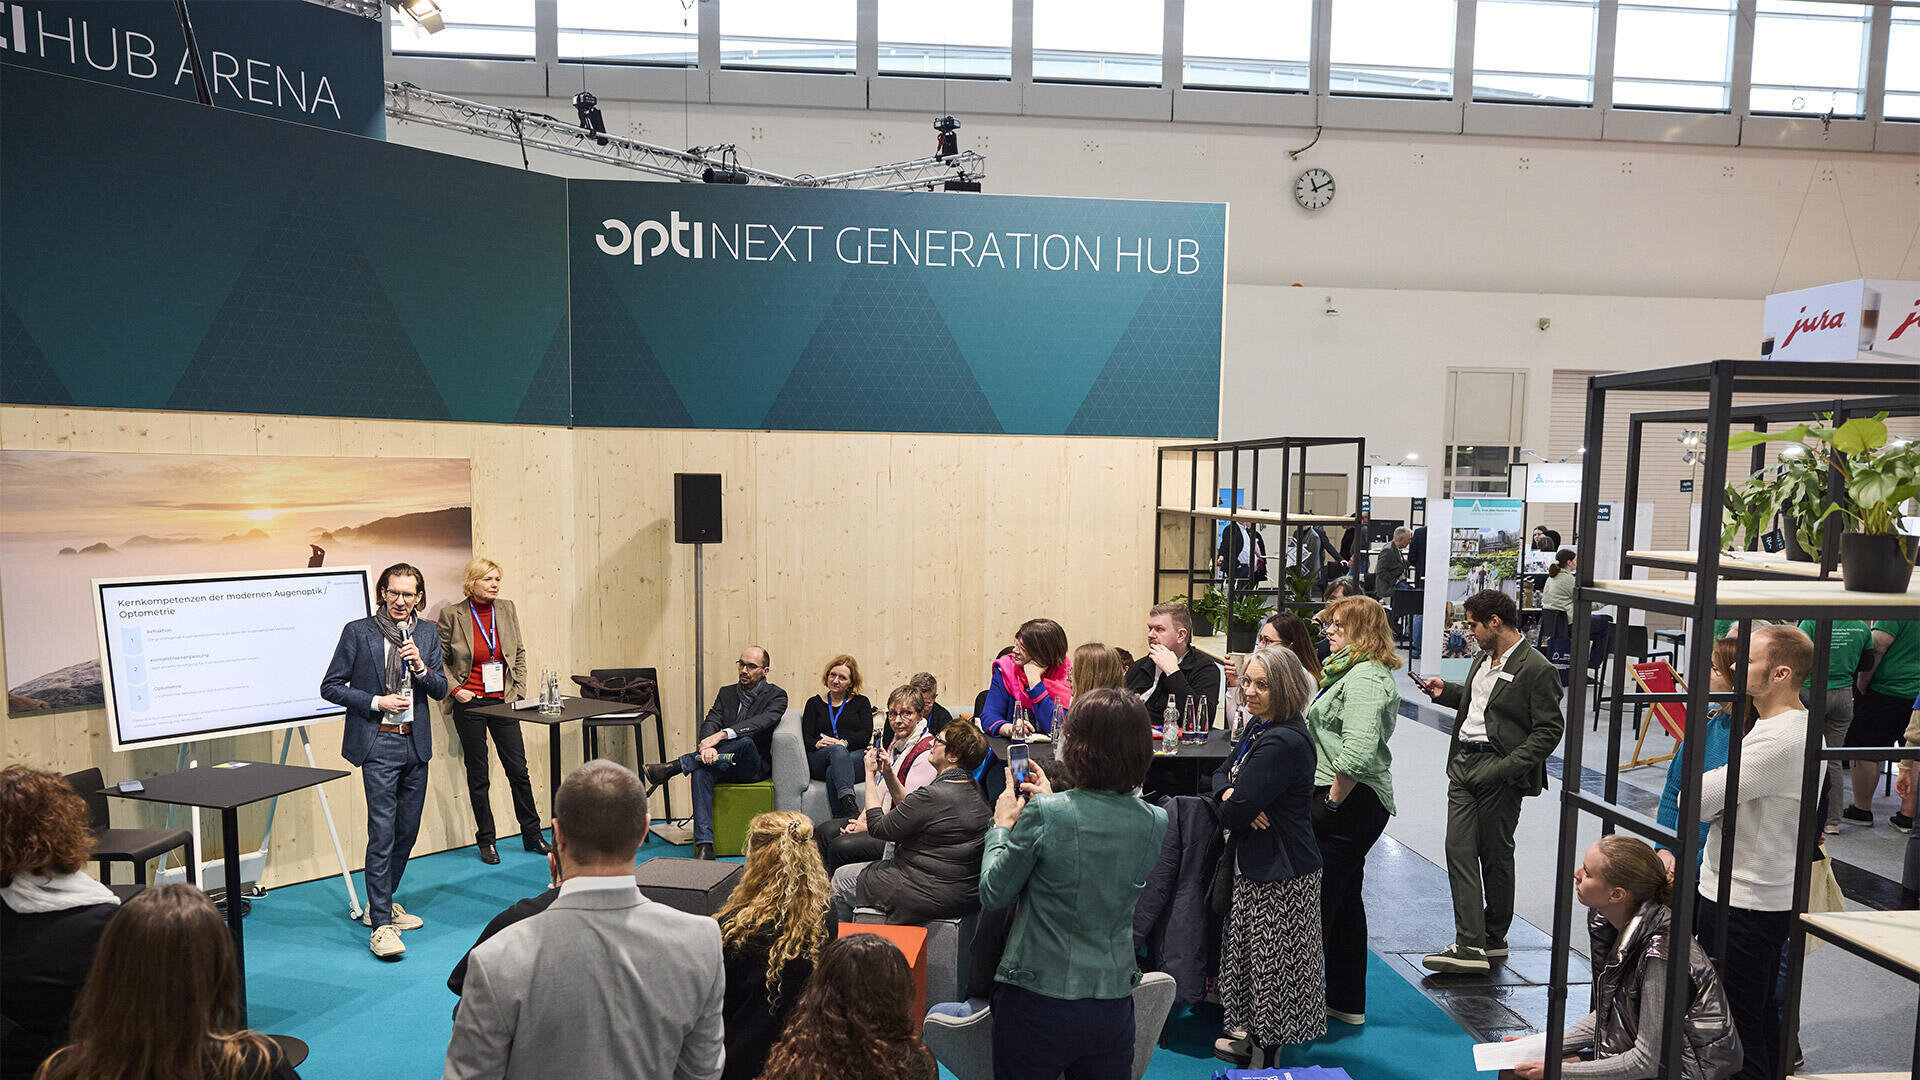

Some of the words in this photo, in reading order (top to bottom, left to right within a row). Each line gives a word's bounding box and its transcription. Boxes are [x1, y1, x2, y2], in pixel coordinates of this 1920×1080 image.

[37, 10, 158, 79] HUB
[712, 222, 823, 262] NEXT
[835, 226, 1100, 272] GENERATION
[1116, 236, 1200, 275] HUB
[1781, 306, 1845, 349] jura
[117, 595, 207, 608] Kernkompetenzen
[209, 593, 224, 601] der
[226, 590, 272, 600] modernen
[273, 587, 323, 598] Augenoptik
[119, 608, 176, 619] Optometrie
